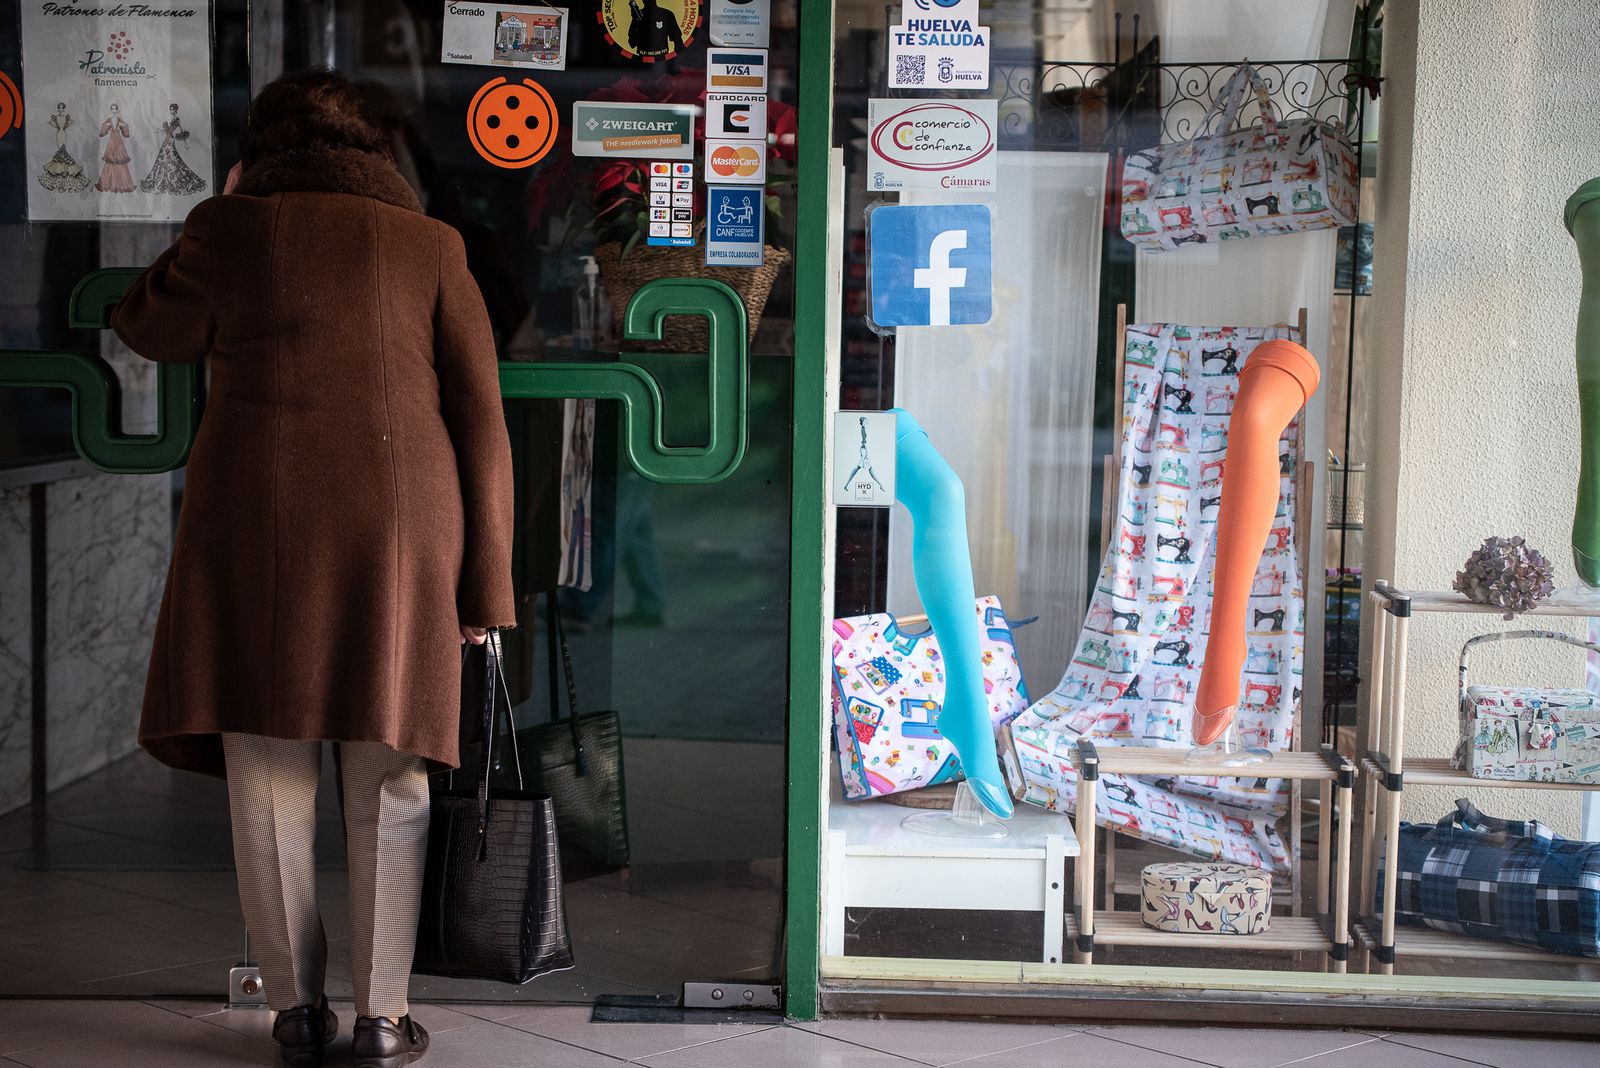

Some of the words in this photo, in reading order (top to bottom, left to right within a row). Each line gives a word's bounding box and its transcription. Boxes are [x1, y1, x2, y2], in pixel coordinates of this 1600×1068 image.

[42, 2, 108, 16] Patrones
[108, 4, 127, 17] de
[127, 4, 197, 17] Flamenca
[450, 6, 485, 16] Cerrado
[605, 16, 616, 33] TOP
[683, 8, 697, 36] HORAS
[908, 19, 972, 32] HUELVA
[895, 33, 916, 46] TE
[918, 33, 985, 46] SALUDA
[78, 49, 146, 77] Patronista
[726, 65, 751, 75] VISA
[94, 79, 138, 87] flamenca
[602, 120, 674, 132] ZWEIGART
[914, 118, 971, 129] comercio
[620, 138, 658, 147] needlework
[659, 137, 679, 147] fabric
[914, 129, 930, 142] de
[914, 138, 973, 151] confianza
[941, 175, 991, 189] Cámaras
[716, 228, 735, 237] CANF
[710, 250, 728, 258] EMPRESA
[728, 251, 760, 259] COLABORADORA
